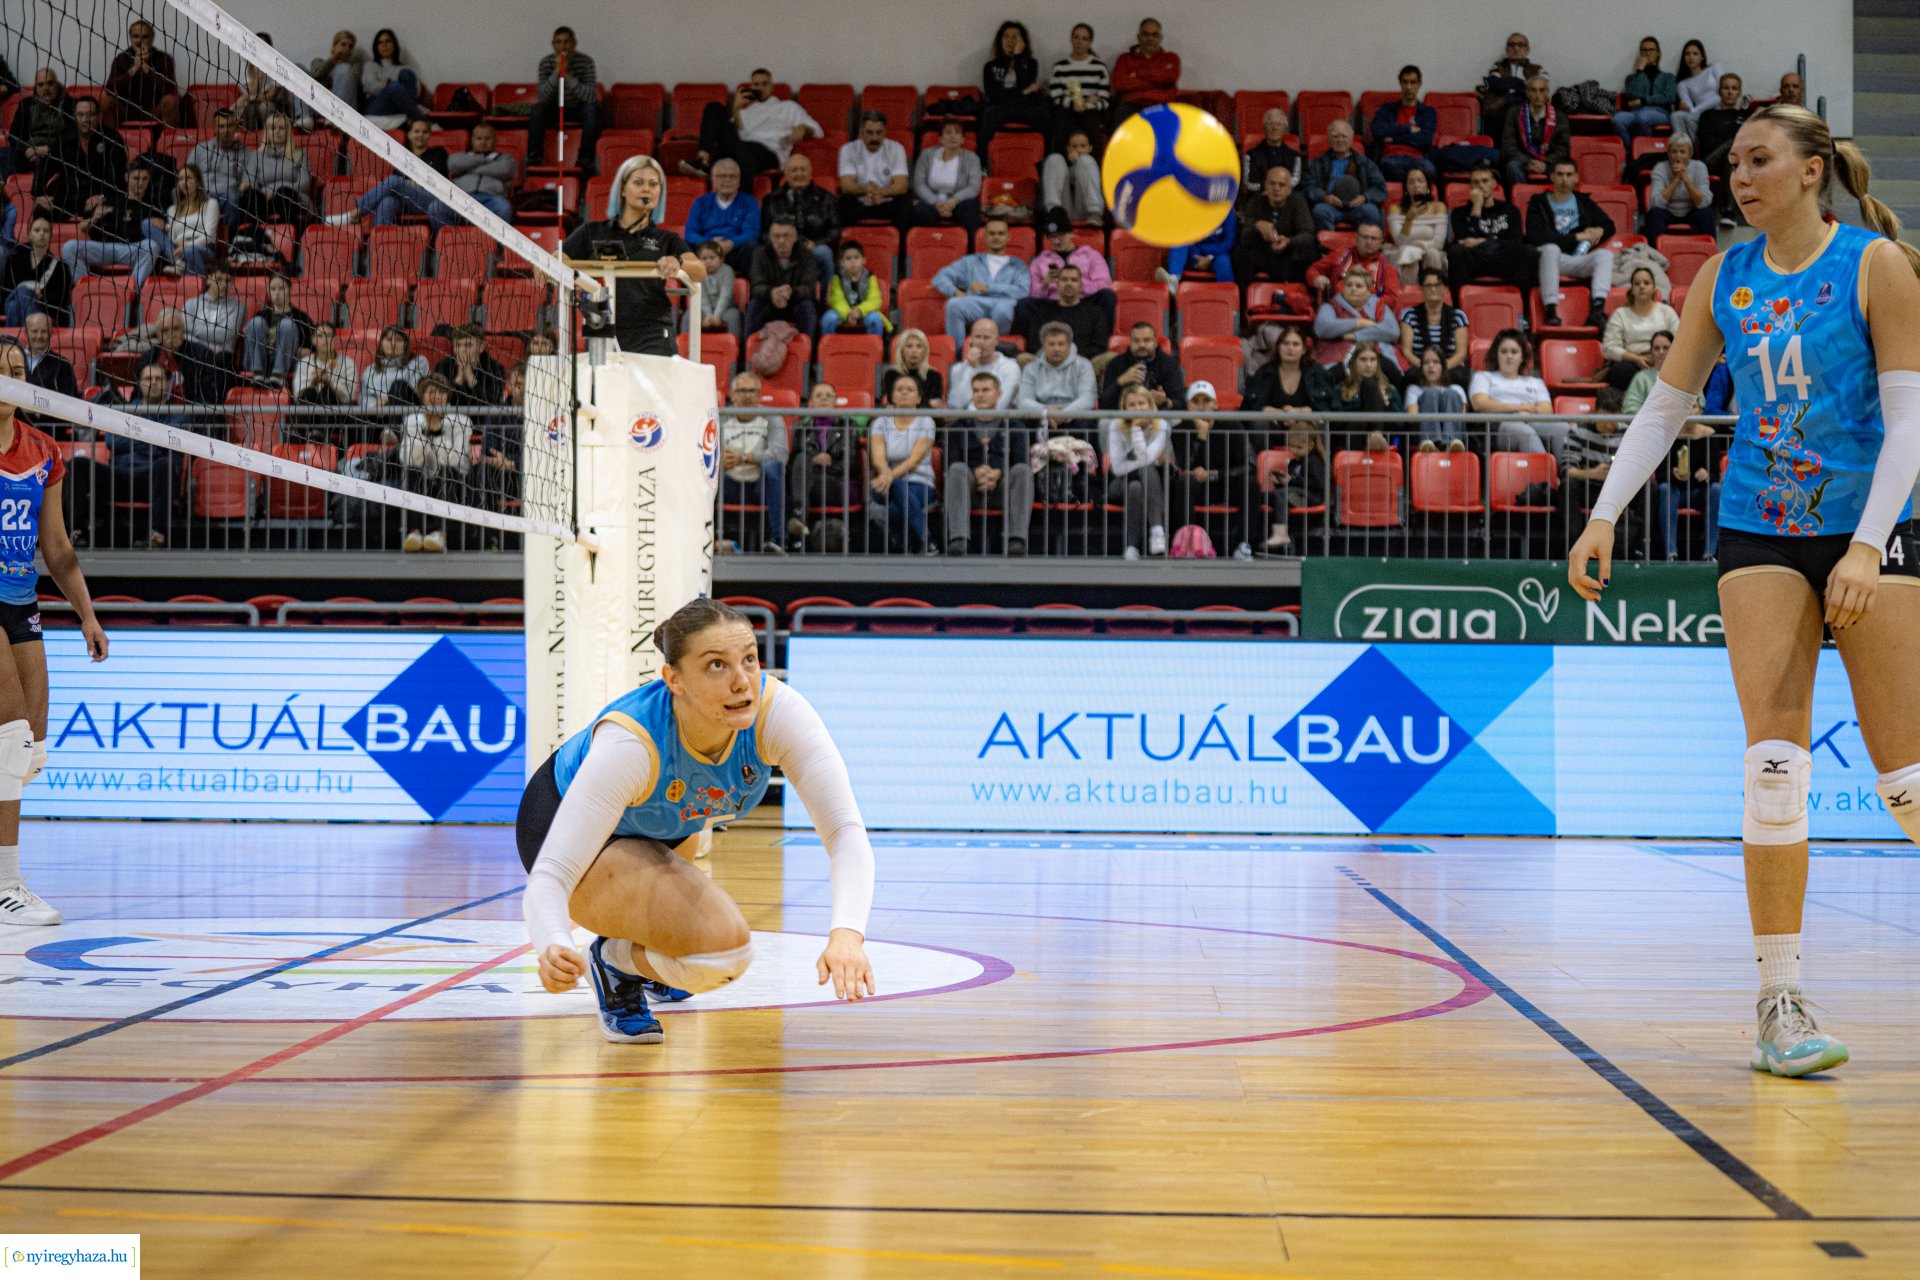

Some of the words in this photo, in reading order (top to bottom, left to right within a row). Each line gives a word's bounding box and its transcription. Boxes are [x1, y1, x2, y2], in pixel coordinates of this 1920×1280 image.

[1747, 335, 1812, 402] 14
[1, 499, 32, 531] 22
[1586, 599, 1723, 642] Neke
[47, 766, 354, 793] www.aktualbau.hu
[971, 778, 1288, 805] www.aktualbau.hu
